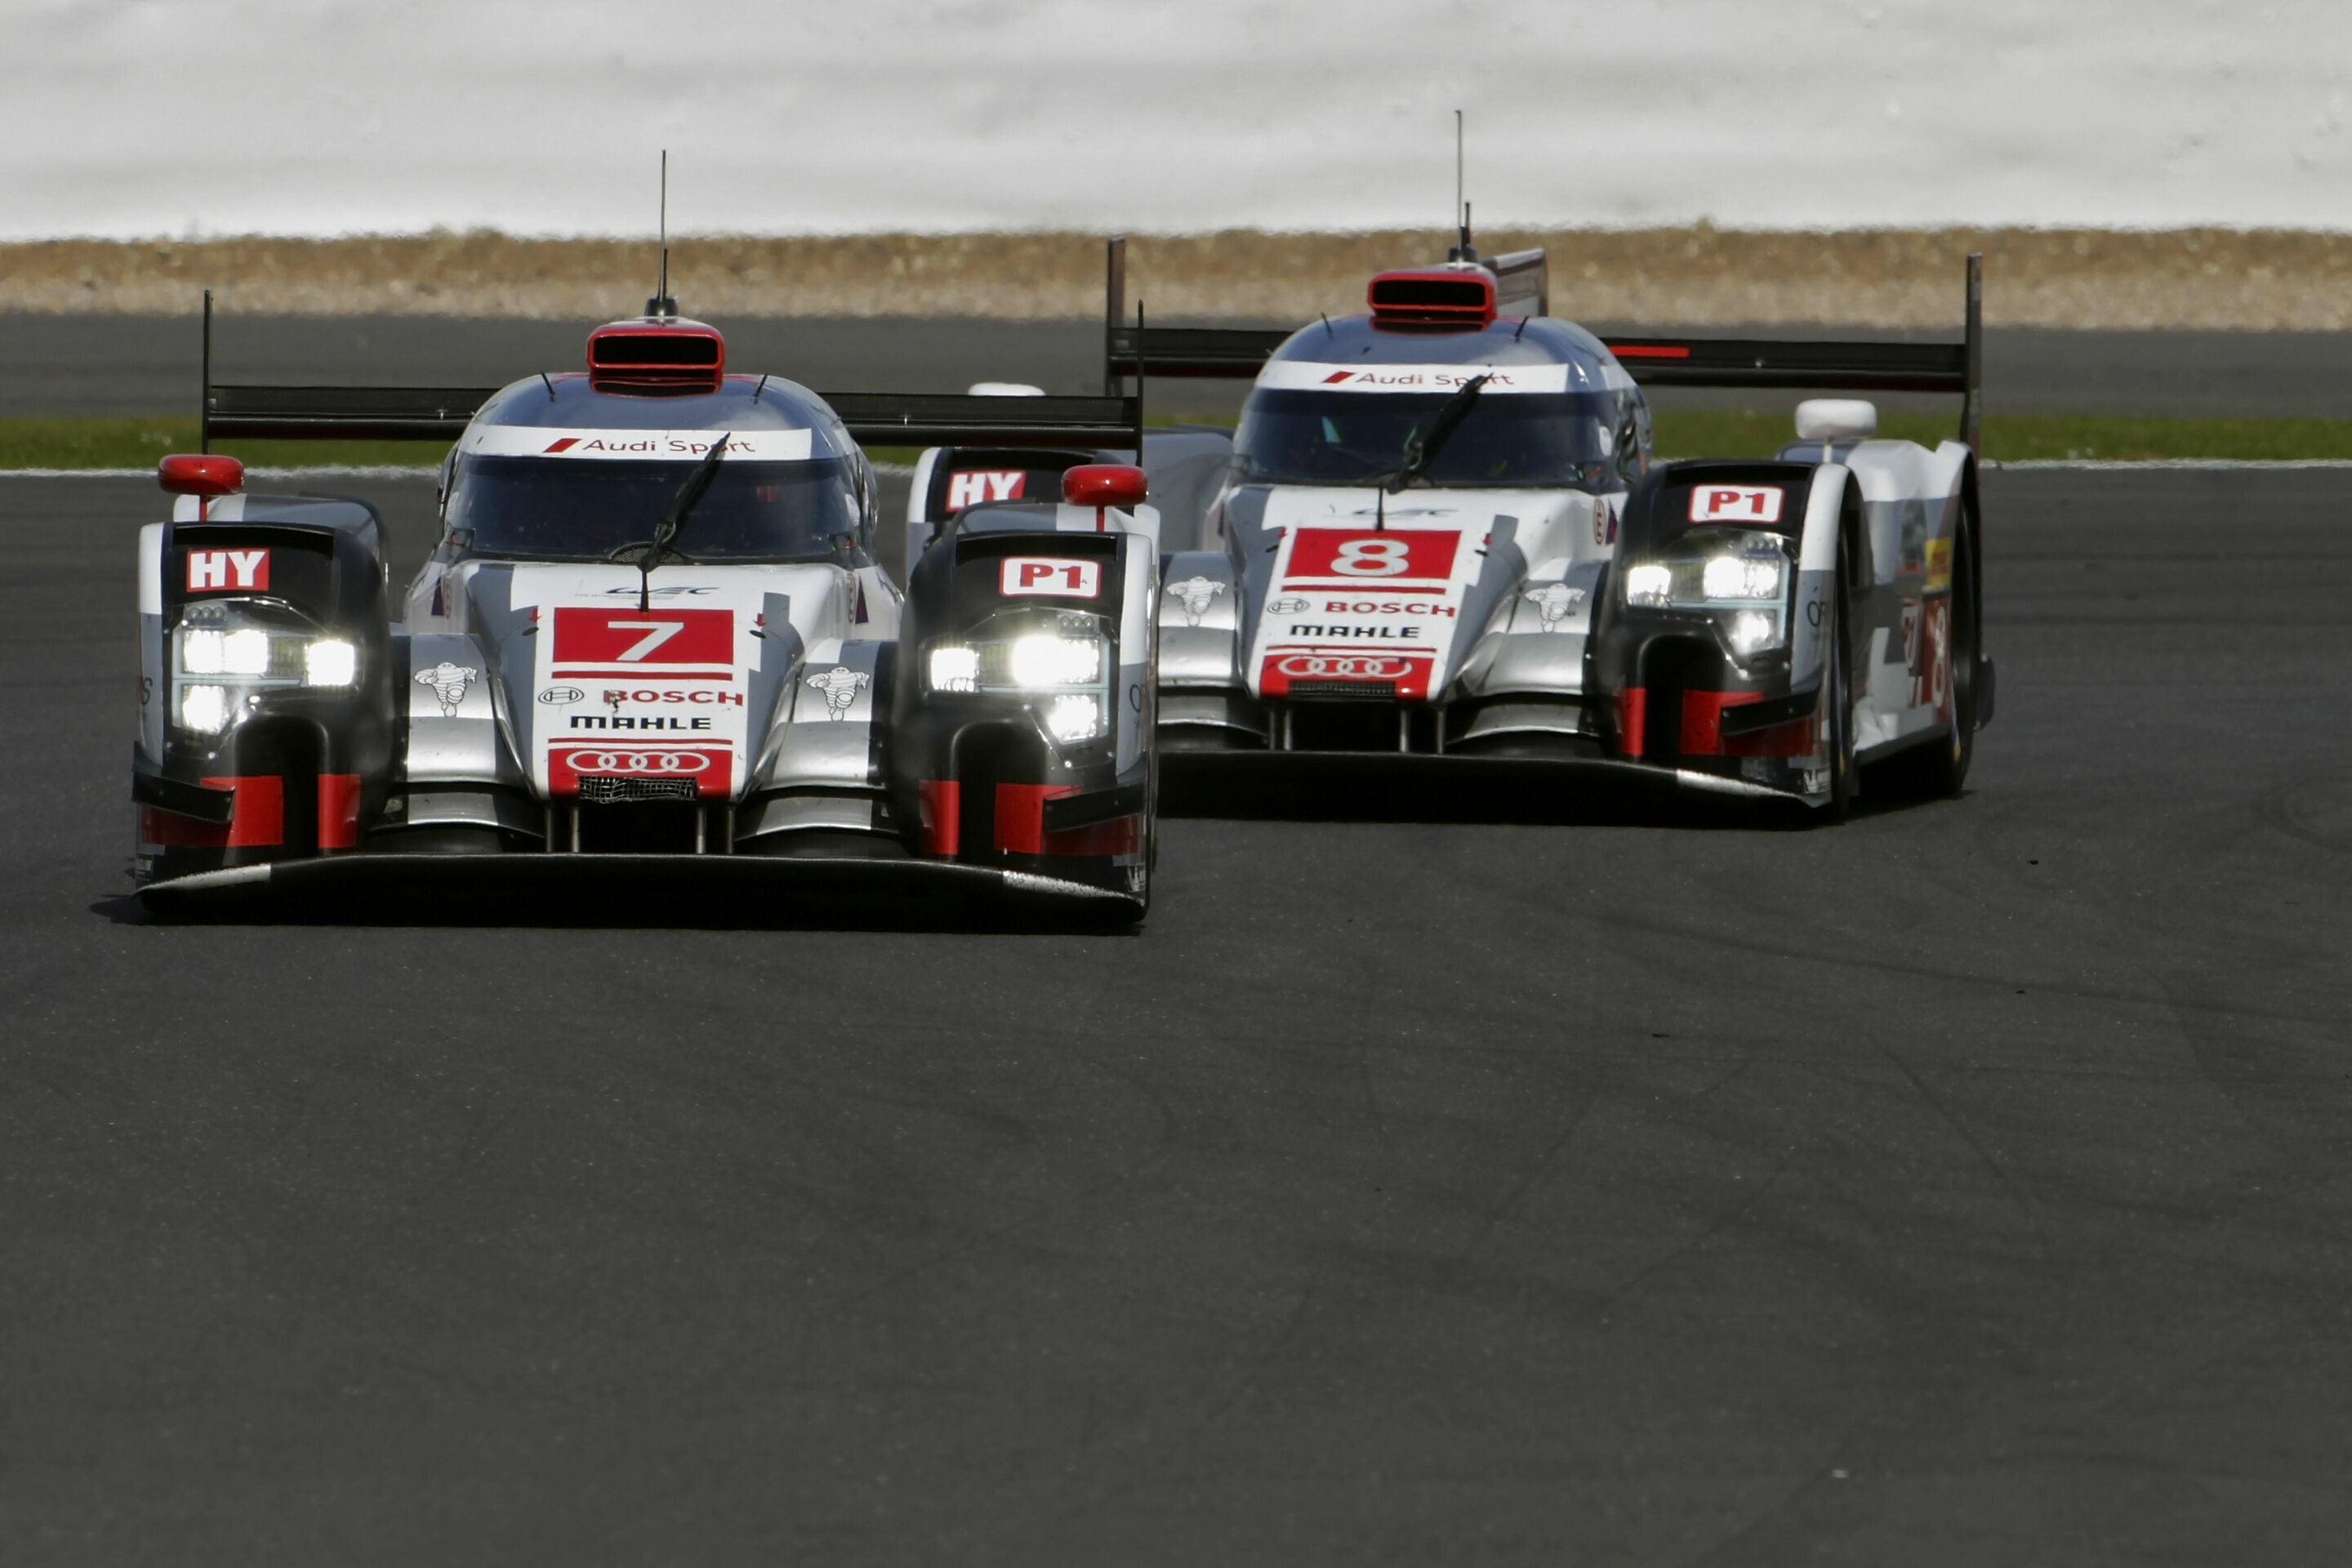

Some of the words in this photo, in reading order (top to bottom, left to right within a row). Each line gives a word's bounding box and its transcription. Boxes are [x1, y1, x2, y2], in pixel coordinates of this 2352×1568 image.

[1356, 372, 1423, 385] Audi
[1435, 374, 1514, 387] Sprt
[583, 439, 657, 452] Audi
[949, 471, 1022, 509] HY
[1708, 491, 1765, 514] P1
[1330, 539, 1410, 577] 8
[189, 551, 267, 588] HY
[1020, 563, 1084, 589] P1
[1325, 601, 1455, 618] BOSCH
[607, 621, 684, 661] 7
[1290, 624, 1420, 639] MAHLE
[603, 690, 743, 706] BOSCH
[570, 715, 711, 730] MAHLE
